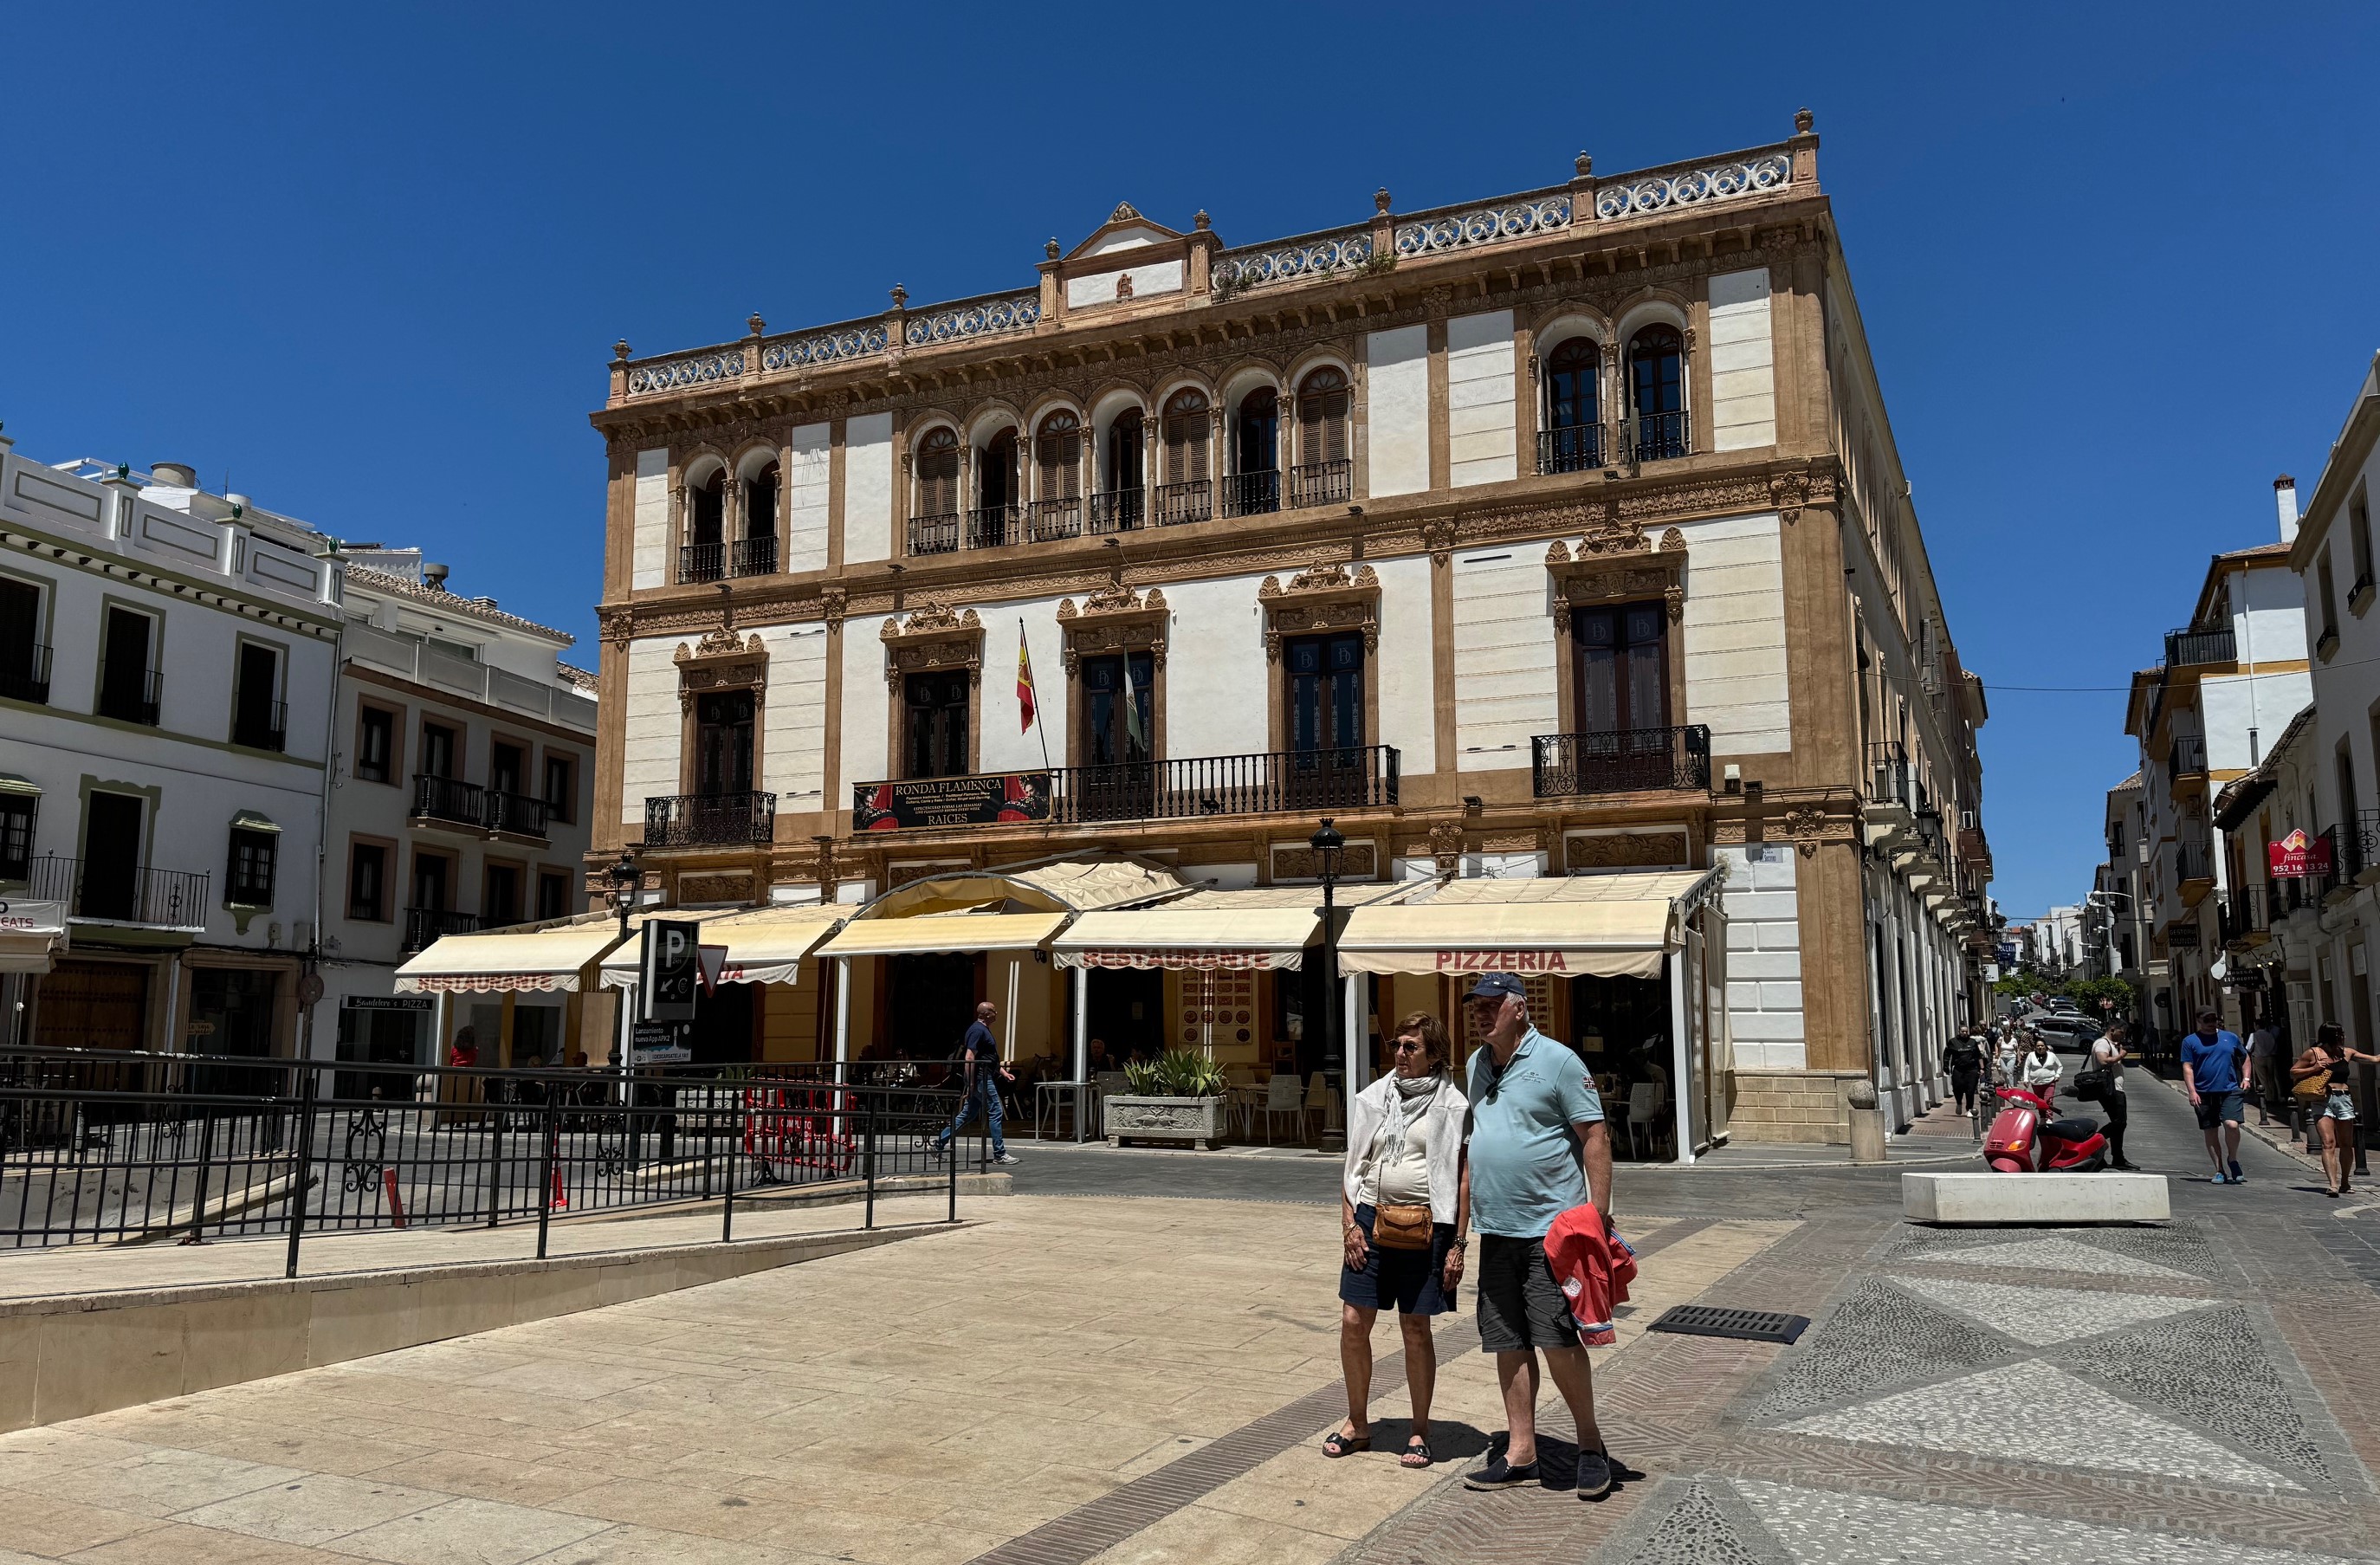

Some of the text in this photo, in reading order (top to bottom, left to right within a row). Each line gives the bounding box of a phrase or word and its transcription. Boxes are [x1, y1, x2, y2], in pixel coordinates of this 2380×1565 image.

[896, 779, 1002, 795] RONDA FLAMENCA
[928, 813, 967, 825] RAICES
[2280, 852, 2317, 864] fincasa
[665, 929, 685, 968] P
[1083, 947, 1271, 967] RESTAURANTE
[1435, 950, 1567, 971] PIZZERIA
[418, 973, 553, 990] RESTAURANTE
[402, 999, 428, 1009] PIZZA
